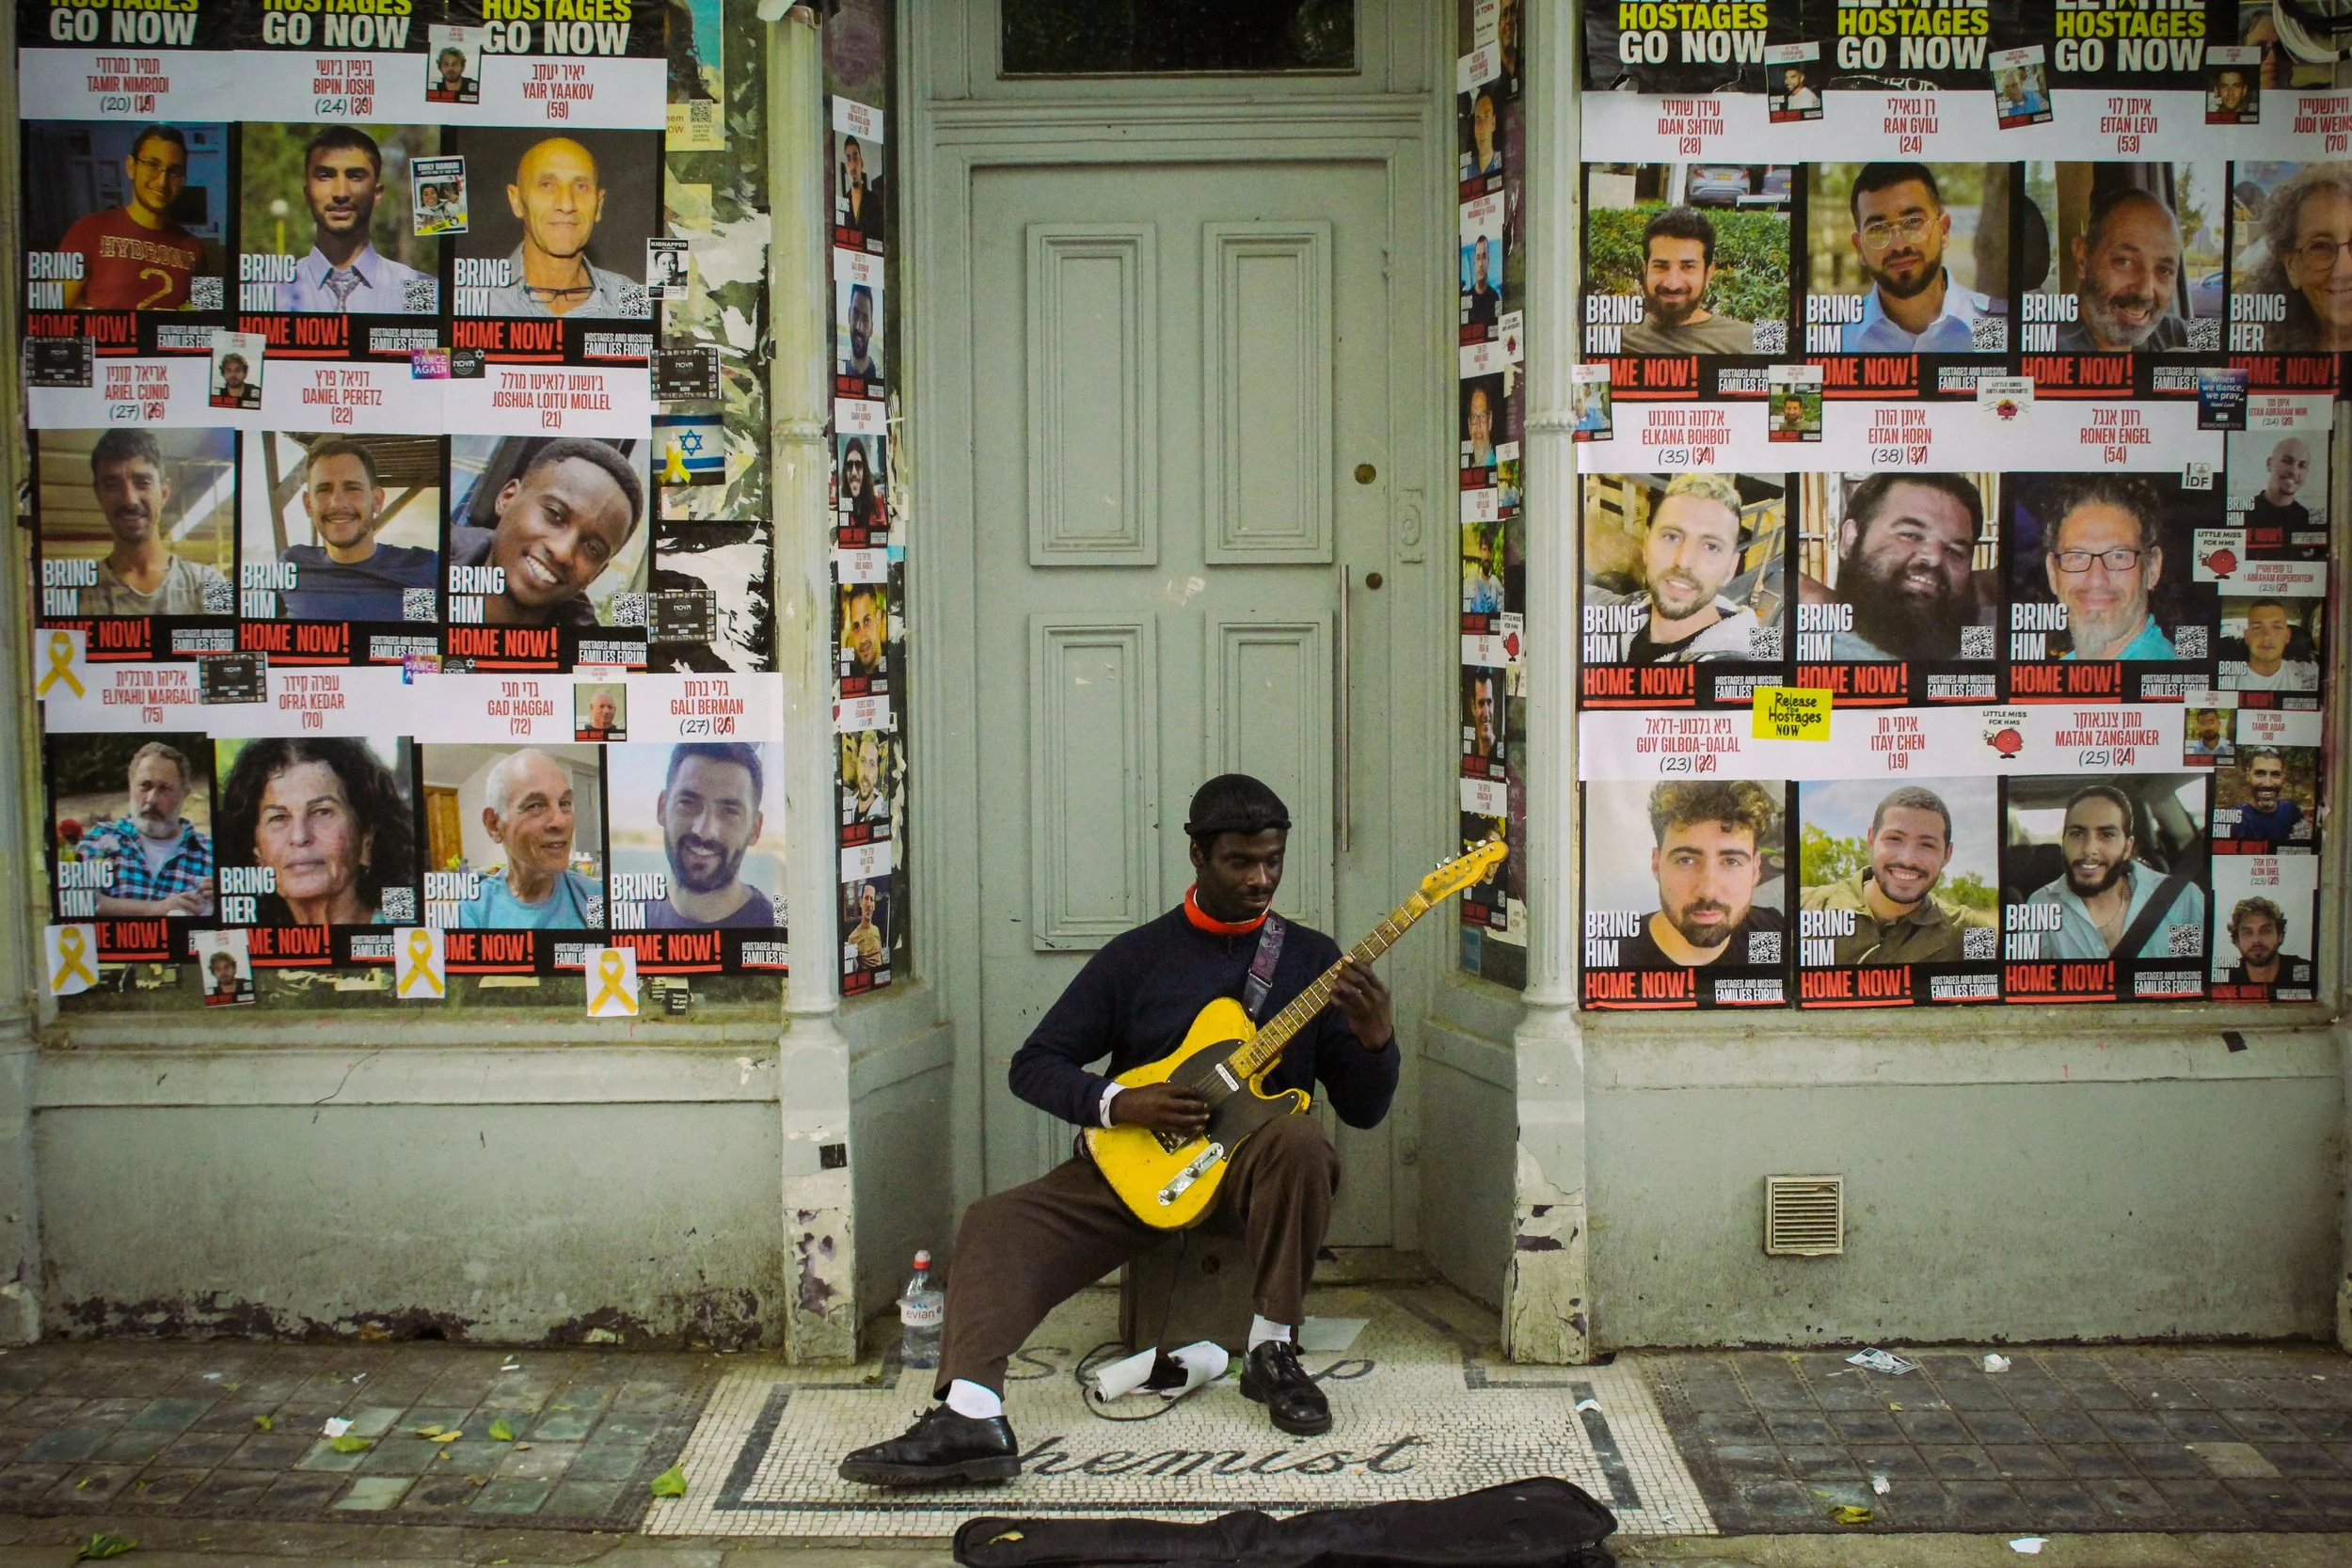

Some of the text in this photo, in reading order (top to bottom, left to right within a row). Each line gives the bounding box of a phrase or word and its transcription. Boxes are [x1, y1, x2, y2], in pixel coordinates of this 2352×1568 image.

[482, 0, 632, 22] HOSTAGES
[1619, 4, 1768, 30] HOSTAGES
[51, 8, 198, 45] GO NOW
[262, 11, 410, 49] GO NOW
[1837, 9, 1989, 36] HOSTAGES
[2056, 11, 2206, 38] HOSTAGES
[482, 20, 531, 54] GO
[545, 23, 629, 55] NOW
[1619, 31, 1668, 65] GO
[1682, 30, 1767, 64] NOW
[1837, 36, 1886, 70] GO
[1899, 36, 1987, 71] NOW
[2055, 39, 2104, 71] GO
[2118, 39, 2204, 71] NOW
[87, 76, 169, 93] TAMIR NIMRODI
[313, 79, 374, 95] BIPIN JOSHI
[523, 83, 594, 100] YAIR YAAKOV
[101, 96, 131, 112] (20)
[547, 102, 569, 119] (59)
[1658, 119, 1723, 135] IDAN SHTIVI
[1884, 118, 1938, 134] RAN GVILI
[2101, 117, 2157, 134] EITAN LEVI
[2293, 117, 2316, 134] JUDI
[1679, 137, 1701, 155] (28)
[1899, 135, 1922, 153] (24)
[2117, 135, 2139, 153] (53)
[2326, 135, 2347, 153] (70)
[454, 258, 511, 287] BRING
[453, 289, 490, 316] HIM
[2231, 293, 2286, 322] BRING
[453, 319, 564, 350] HOME NOW!
[2230, 325, 2265, 352] HER
[414, 356, 446, 365] DANCE
[415, 365, 446, 374] AGAIN
[105, 385, 169, 400] ARIEL CUNIO
[303, 388, 382, 405] DANIEL PERETZ
[492, 391, 611, 410] JOSHUA LOITU MOLLEL
[109, 404, 139, 420] (27)
[331, 407, 353, 425] (22)
[542, 411, 562, 429] (21)
[1642, 429, 1731, 445] ELKANA BOHBOT
[1868, 429, 1931, 444] EITAN HORN
[2080, 428, 2152, 444] RONEN ENGEL
[2104, 446, 2126, 465] (54)
[2186, 476, 2208, 487] IDF
[1584, 606, 1640, 633] BRING
[1584, 635, 1617, 663] HIM
[1584, 665, 1693, 695] HOME NOW!
[103, 689, 144, 705] ELIYAHU
[279, 694, 344, 709] OFRA KEDAR
[1775, 692, 1817, 708] Release
[143, 707, 163, 724] (75)
[488, 700, 553, 716] GAD HAGGAI
[671, 699, 743, 715] GALI BERMAN
[1769, 706, 1821, 726] Hostages
[302, 711, 323, 729] (70)
[510, 718, 532, 736] (72)
[1775, 724, 1800, 736] NOW
[2056, 730, 2159, 746] MATAN ZANGAUKER
[1637, 736, 1740, 752] GUY GILBOA-DALAL
[1871, 735, 1925, 751] ITAY CHEN
[1888, 752, 1908, 770] (19)
[220, 866, 276, 894] BRING
[221, 895, 257, 923] HER
[2007, 903, 2062, 931] BRING
[1585, 911, 1640, 939] BRING
[278, 924, 330, 954] NOW!
[2006, 933, 2040, 959] HIM
[1585, 940, 1618, 967] HIM
[1585, 968, 1695, 999] HOME NOW!
[1715, 979, 1782, 989] HOSTAGES AND MISSING
[2005, 960, 2115, 992] HOME NOW!
[1715, 989, 1783, 1002] FAMILIES FORUM
[907, 1310, 934, 1319] evian
[1020, 1435, 1433, 1476] hemist
